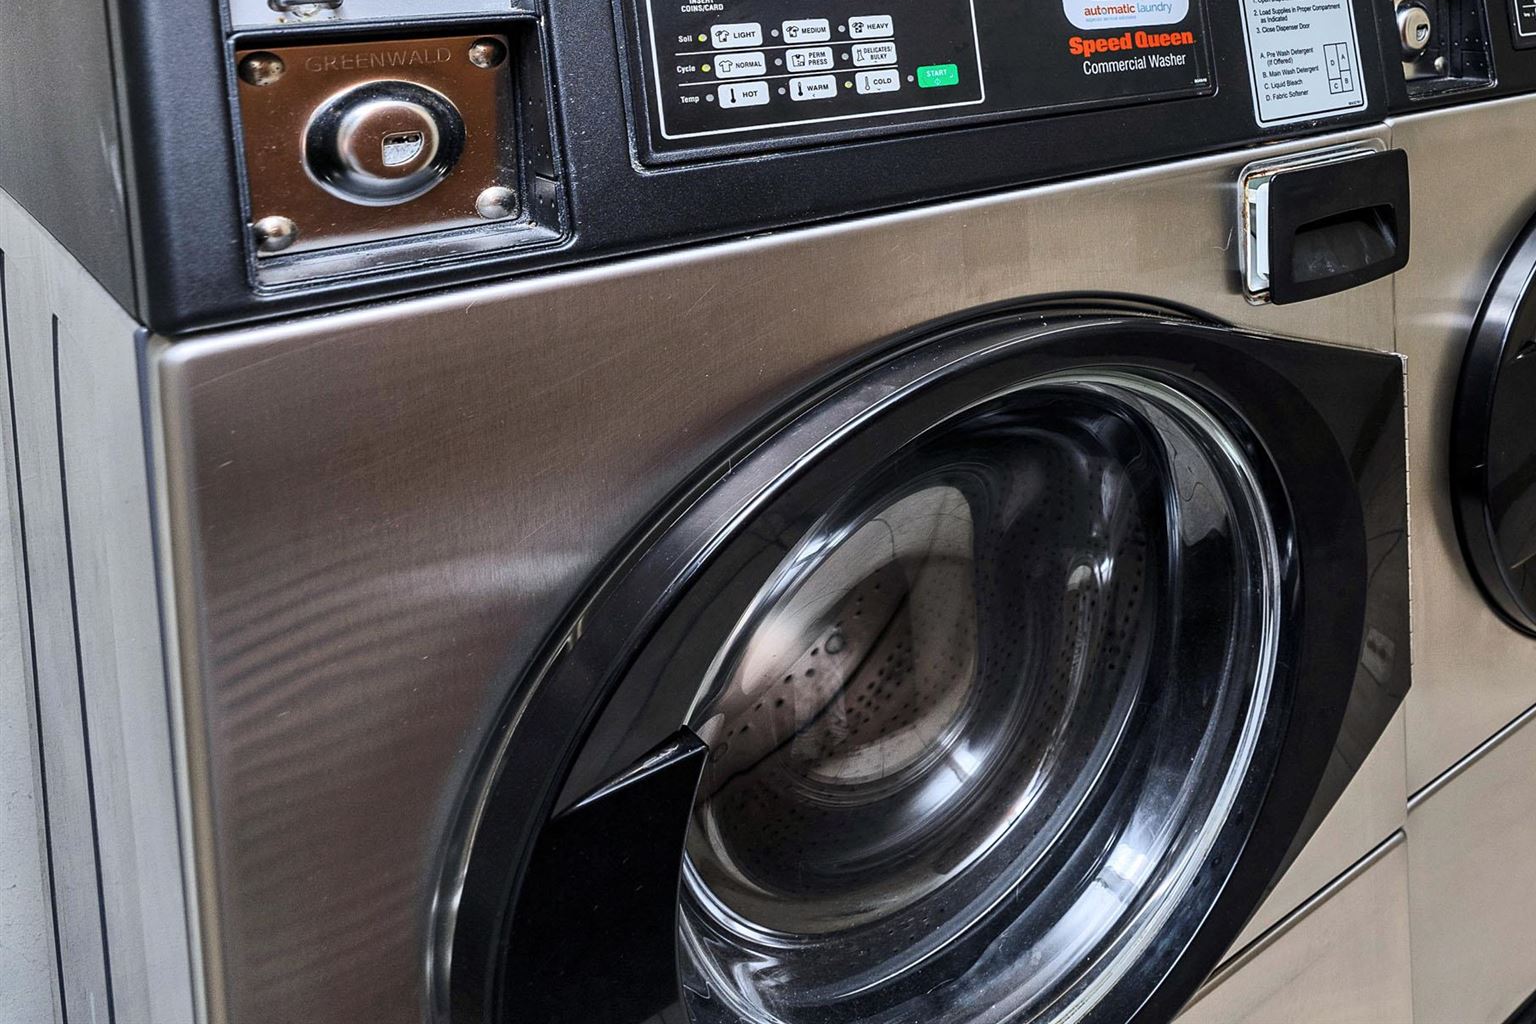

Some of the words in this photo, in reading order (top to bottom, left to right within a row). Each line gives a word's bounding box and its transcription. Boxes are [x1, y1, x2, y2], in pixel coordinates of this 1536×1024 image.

[681, 4, 724, 12] COINS/CARD
[1085, 4, 1135, 16] automatic
[1137, 2, 1172, 13] laundry
[1276, 24, 1298, 32] Dispenser
[1069, 32, 1132, 57] Speed
[1135, 31, 1194, 48] Queen
[305, 48, 451, 72] GREENWALD
[1083, 56, 1146, 74] Commercial
[1148, 53, 1186, 68] Washer
[677, 65, 695, 73] Cycle
[926, 69, 947, 77] START
[1296, 66, 1319, 74] Detergent
[1271, 81, 1286, 89] Liquid
[1289, 90, 1308, 98] Softener
